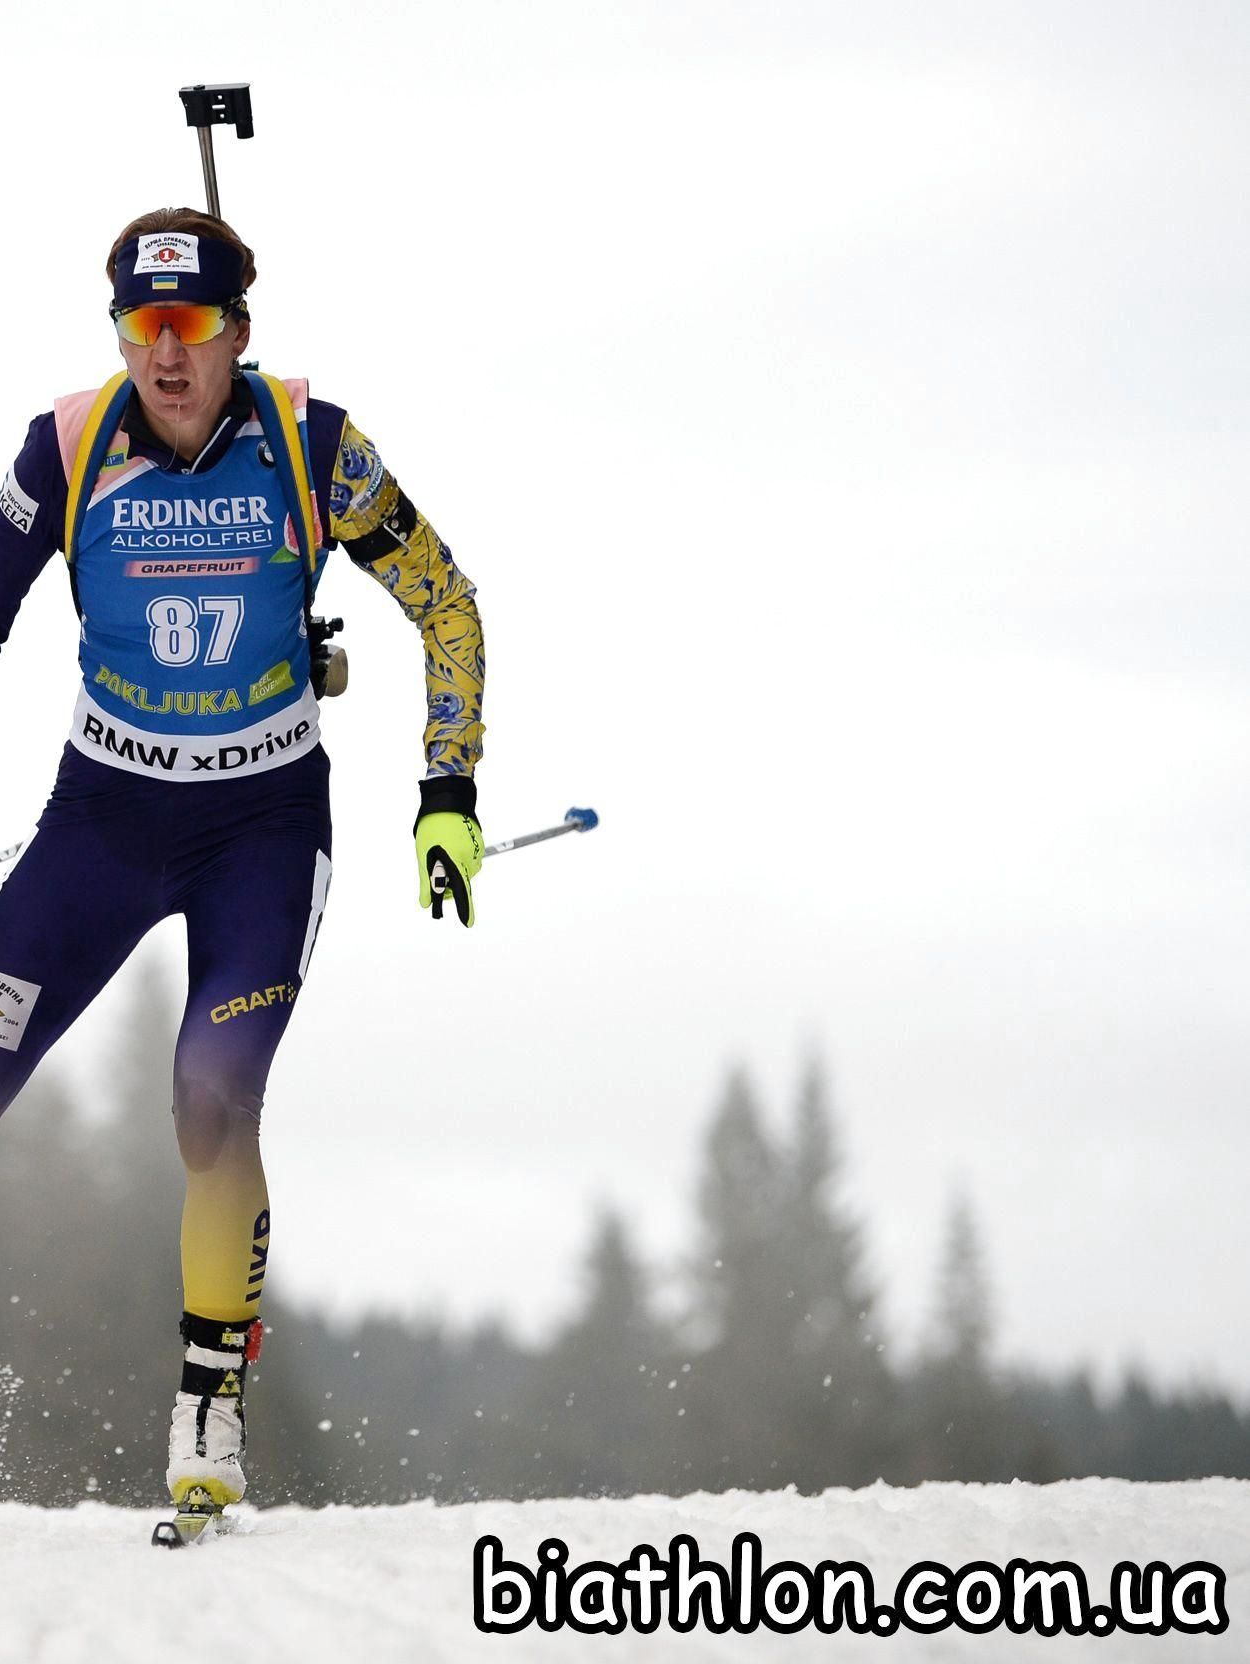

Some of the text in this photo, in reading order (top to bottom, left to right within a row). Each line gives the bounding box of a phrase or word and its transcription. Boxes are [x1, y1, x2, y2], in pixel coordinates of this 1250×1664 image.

[162, 250, 171, 260] 1
[6, 488, 33, 518] TERCIUM
[111, 495, 274, 531] ERDINGER
[111, 529, 273, 548] ALKOHOLFREI
[141, 561, 246, 574] GRAPEFRUIT
[146, 595, 245, 667] 87
[93, 664, 243, 715] PAKLJUKA
[83, 713, 311, 771] BMW xDrive
[210, 984, 286, 1024] CRAFT
